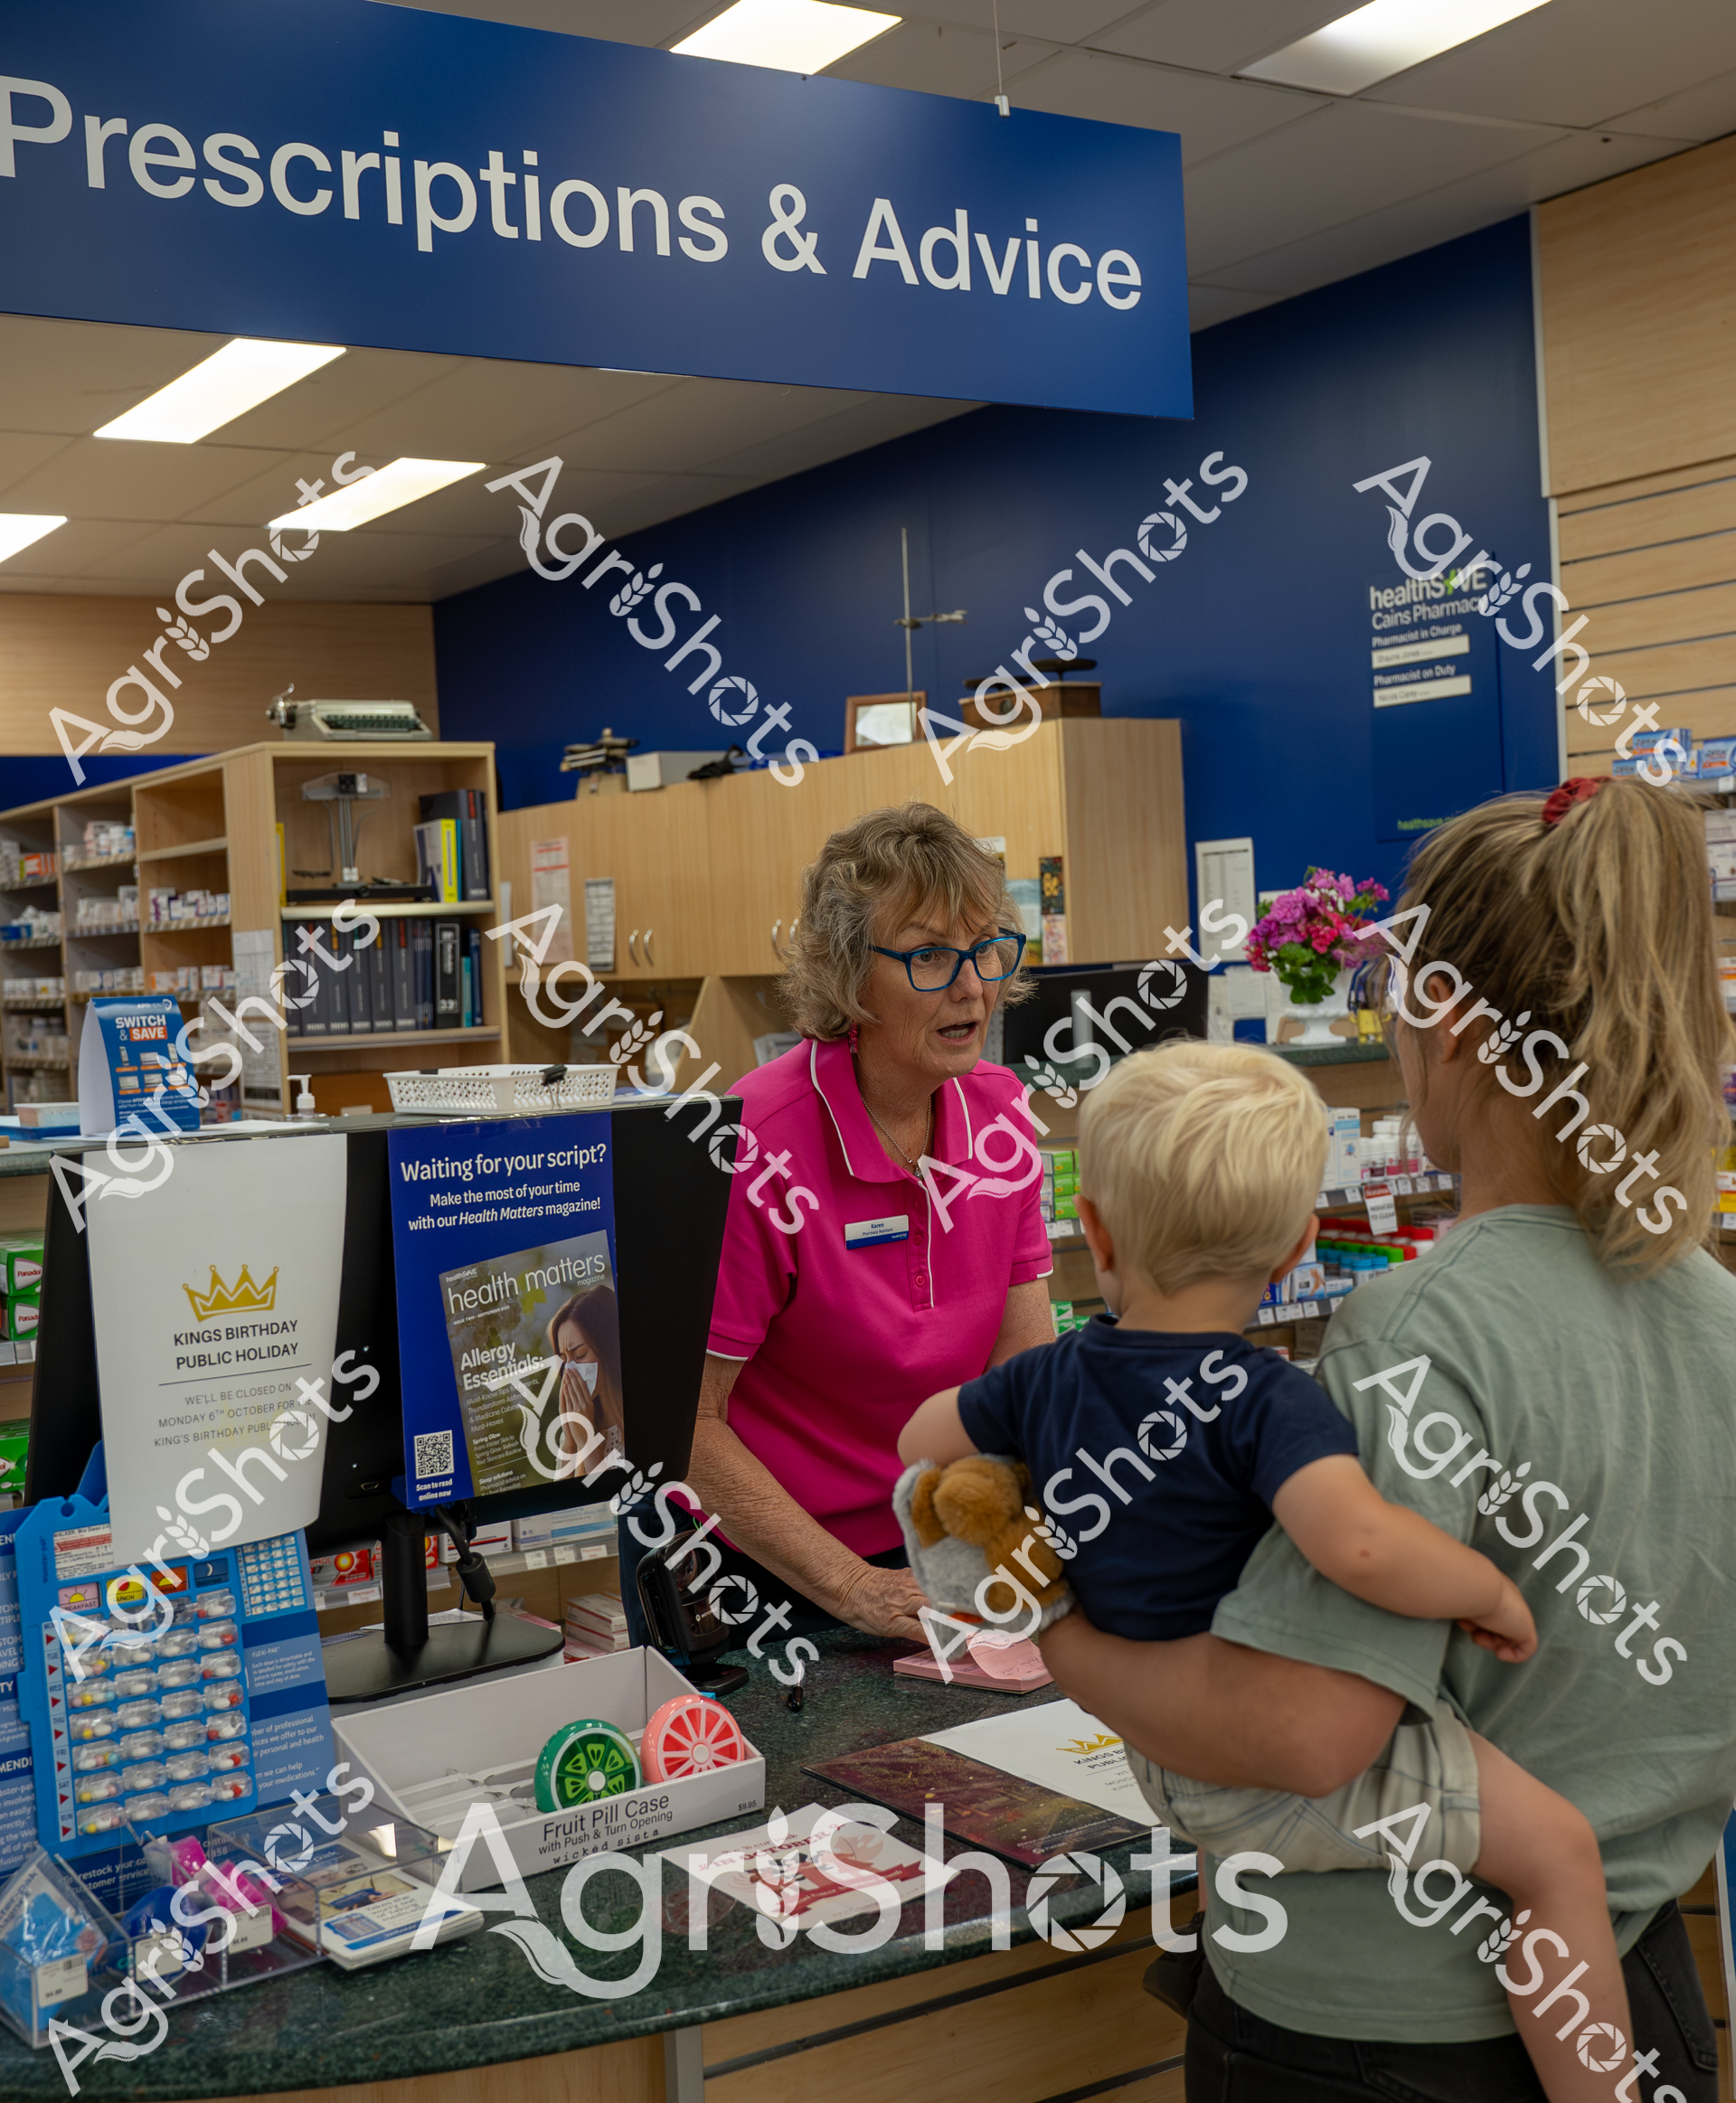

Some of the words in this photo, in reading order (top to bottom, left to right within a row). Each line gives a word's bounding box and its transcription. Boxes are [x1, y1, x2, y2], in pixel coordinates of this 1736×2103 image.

[0, 76, 730, 253] Prescriptions
[761, 183, 827, 276] &
[853, 196, 1144, 311] Advice
[1372, 608, 1412, 631] Cains
[1372, 630, 1420, 648] Pharmacist
[1420, 627, 1430, 639] in
[1429, 623, 1463, 638] Charge
[1373, 669, 1421, 687] Pharmacist
[1422, 668, 1434, 679] on
[1434, 664, 1457, 679] Duty
[115, 1014, 166, 1029] SWITCH
[119, 1029, 128, 1041] &
[132, 1026, 165, 1040] SAVE
[401, 1156, 474, 1182] Waiting
[475, 1154, 502, 1175] for
[504, 1152, 544, 1176] your
[546, 1143, 607, 1169] script?
[429, 1193, 462, 1208] Make
[463, 1189, 484, 1204] the
[485, 1186, 514, 1202] most
[515, 1183, 527, 1198] of
[528, 1184, 553, 1199] your
[554, 1179, 580, 1193] time
[408, 1215, 435, 1231] with
[437, 1214, 458, 1227] our
[458, 1208, 498, 1226] Health
[499, 1204, 544, 1221] Matters
[545, 1197, 601, 1217] magazine!
[17, 1268, 42, 1278] Panadol
[448, 1271, 519, 1314] health
[524, 1254, 606, 1293] matters
[577, 1273, 606, 1287] magazine
[174, 1329, 222, 1346] KINGS
[225, 1320, 298, 1341] BIRTHDAY
[176, 1351, 232, 1370] PUBLIC
[235, 1342, 298, 1363] HOLIDAY
[460, 1342, 516, 1372] Allergy
[463, 1353, 545, 1391] Essentials:
[185, 1392, 218, 1406] WE'LL
[220, 1391, 233, 1400] BE
[236, 1384, 276, 1399] CLOSED
[278, 1382, 292, 1392] ON
[158, 1413, 206, 1429] MONDAY
[227, 1402, 275, 1419] OCTOBER
[277, 1399, 295, 1410] FOR
[155, 1433, 190, 1447] KING'S
[193, 1426, 245, 1442] BIRTHDAY
[248, 1419, 281, 1434] PUBLIC
[283, 1412, 317, 1429] HOLIDAY
[415, 1483, 431, 1492] Scan
[431, 1481, 439, 1489] to
[439, 1478, 453, 1488] read
[419, 1492, 438, 1502] online
[439, 1489, 451, 1497] now
[47, 1652, 60, 1660] TUE
[49, 1683, 63, 1693] WED
[53, 1716, 65, 1724] THU
[266, 1723, 274, 1733] of
[274, 1714, 314, 1733] professional
[280, 1730, 297, 1741] offer
[307, 1725, 317, 1733] our
[56, 1749, 67, 1757] FRI
[259, 1741, 288, 1758] personal
[289, 1739, 302, 1749] and
[303, 1733, 325, 1745] health
[263, 1768, 274, 1777] we
[275, 1767, 288, 1775] can
[288, 1761, 303, 1771] help
[1073, 1751, 1115, 1765] KINGS
[59, 1780, 70, 1789] SAT
[259, 1781, 274, 1792] your
[738, 1799, 758, 1812] $9.95
[61, 1813, 73, 1822] SUN
[543, 1814, 586, 1842] Fruit
[592, 1803, 619, 1829] Pill
[625, 1794, 670, 1818] Case
[538, 1841, 561, 1855] with
[564, 1832, 590, 1848] Push
[593, 1828, 601, 1839] &
[604, 1821, 627, 1839] Turn
[629, 1808, 674, 1831] Opening
[617, 1826, 660, 1847] sista
[741, 1831, 832, 1861] OCTOBER
